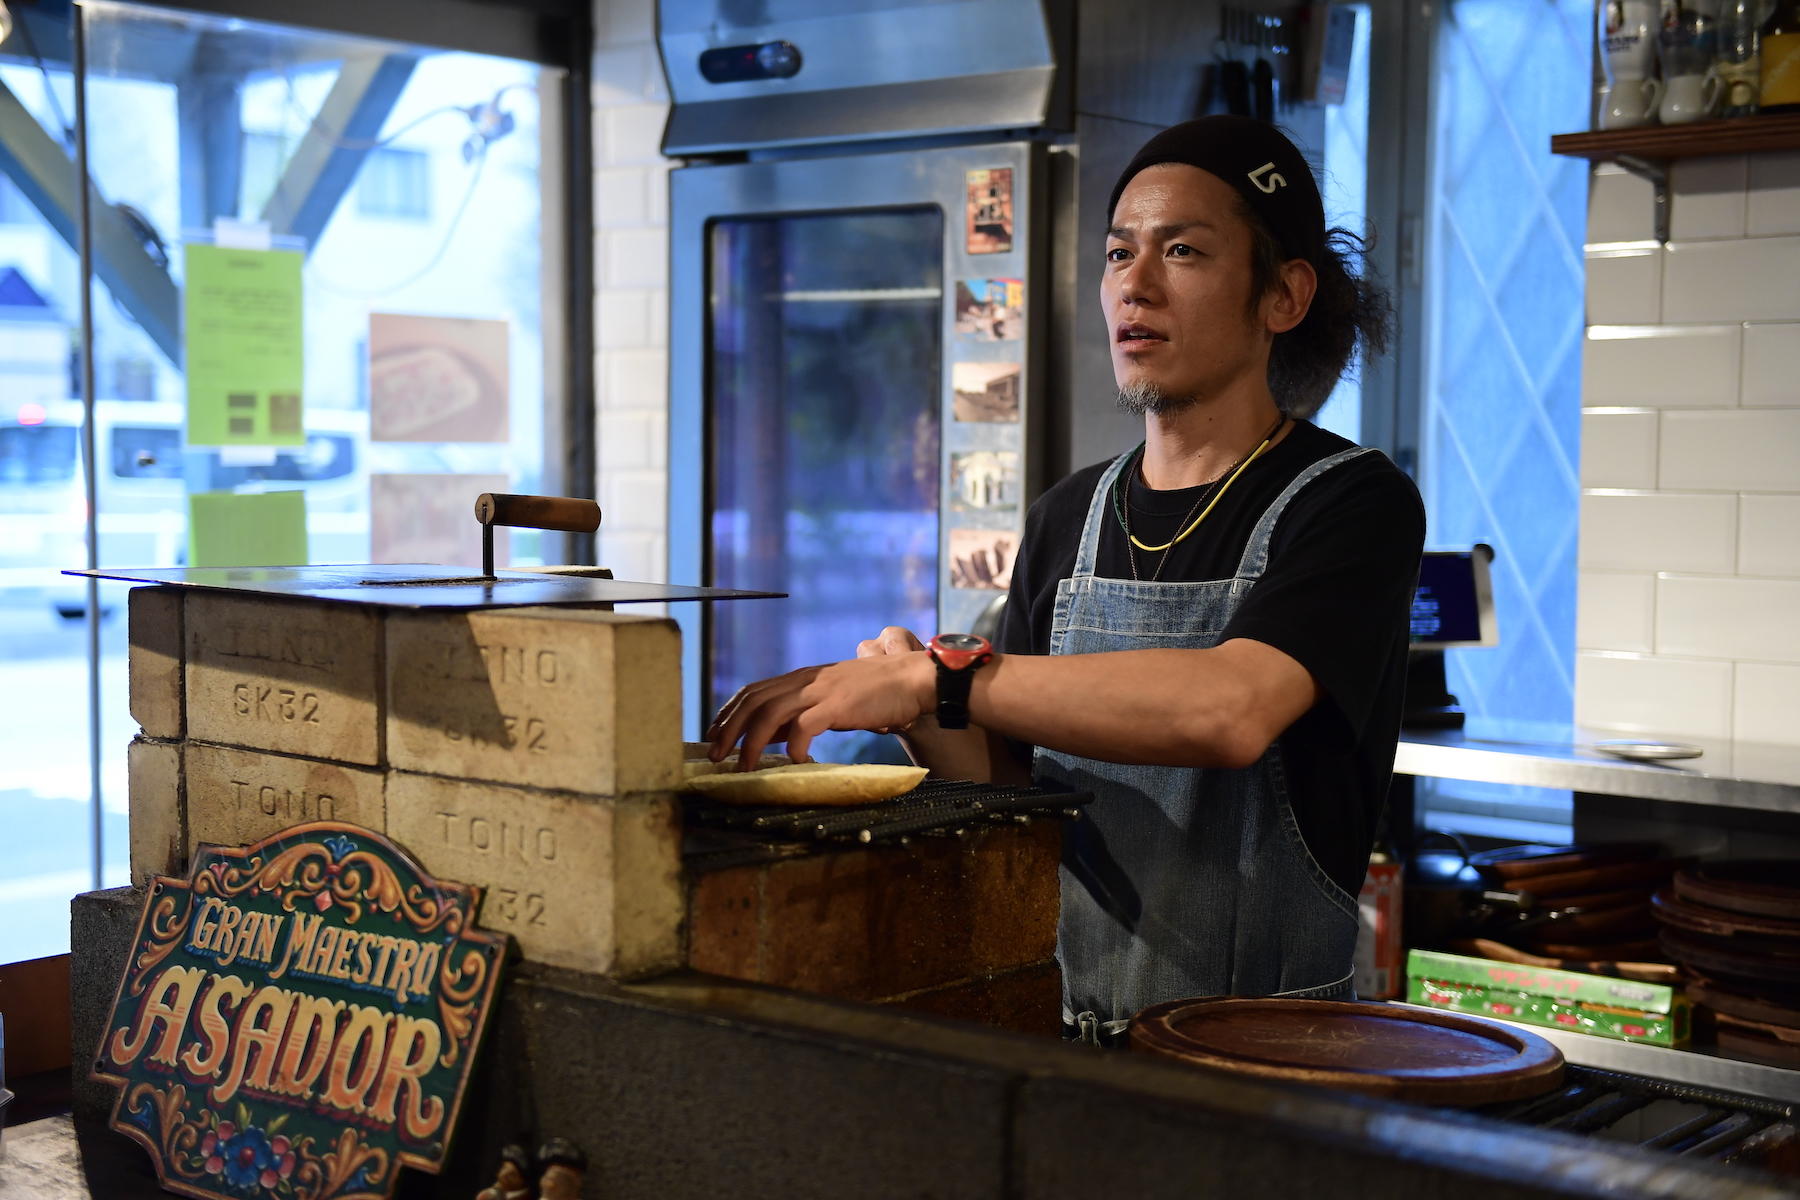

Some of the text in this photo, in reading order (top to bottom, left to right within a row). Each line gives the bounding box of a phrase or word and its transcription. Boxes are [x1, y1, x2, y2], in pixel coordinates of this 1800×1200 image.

[233, 683, 321, 726] SK32
[435, 810, 557, 867] TONO
[192, 896, 444, 1002] GRAN MAESTRO
[111, 964, 444, 1138] ASADOR
